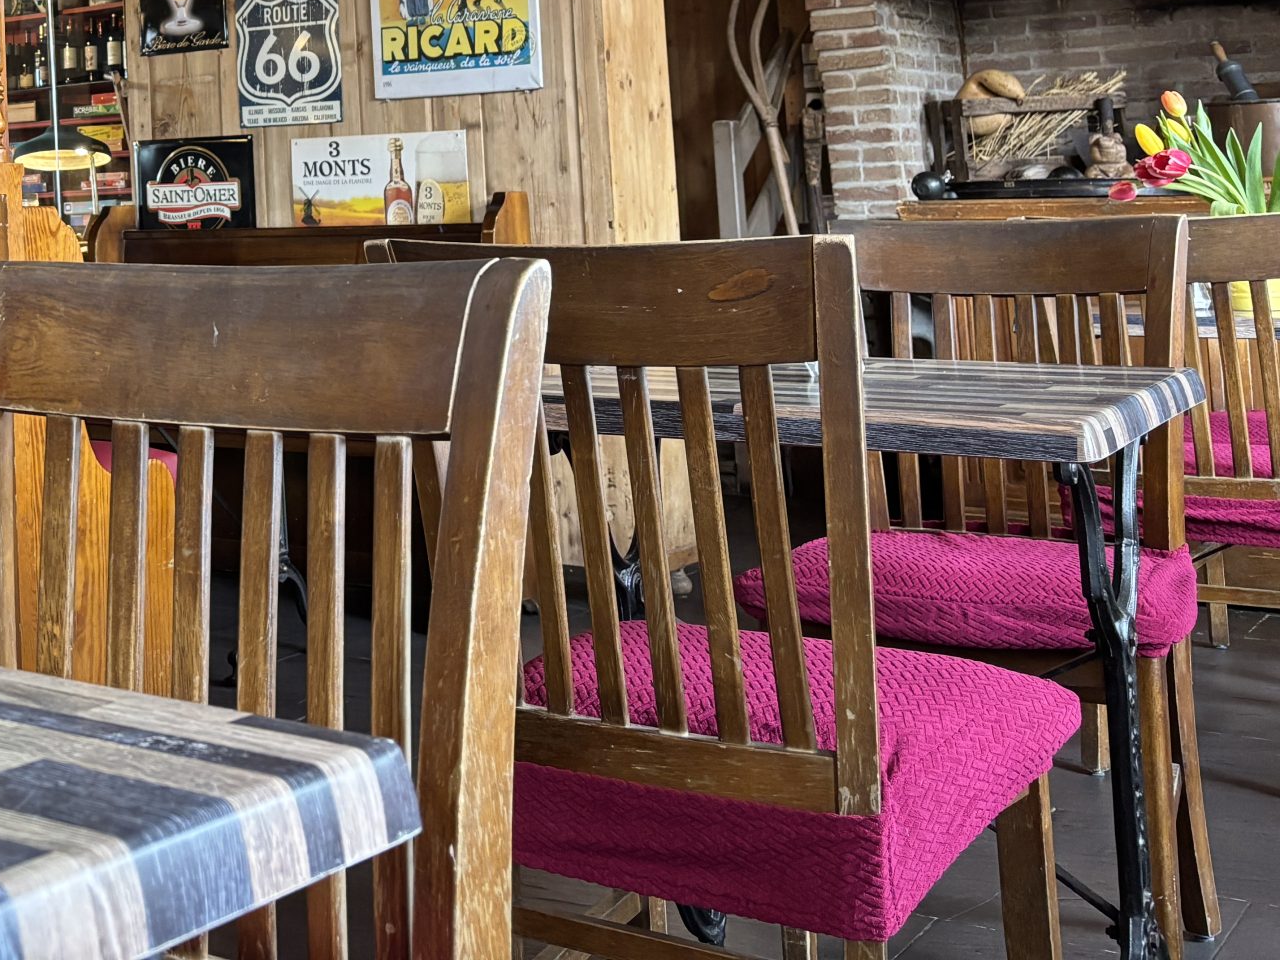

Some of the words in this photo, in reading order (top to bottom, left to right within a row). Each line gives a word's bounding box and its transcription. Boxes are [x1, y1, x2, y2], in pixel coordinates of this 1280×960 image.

[263, 3, 308, 24] ROUTE
[381, 17, 528, 63] RICARD
[255, 30, 320, 85] 66
[389, 61, 401, 74] le
[403, 58, 456, 74] vainqueur
[460, 56, 476, 68] de
[479, 54, 492, 67] la
[493, 49, 523, 67] soif
[328, 140, 341, 158] 3
[170, 155, 217, 179] BIERE
[302, 158, 372, 179] MONTS
[424, 186, 433, 200] 3
[192, 207, 213, 217] DEPUIS
[419, 202, 442, 211] MONTS
